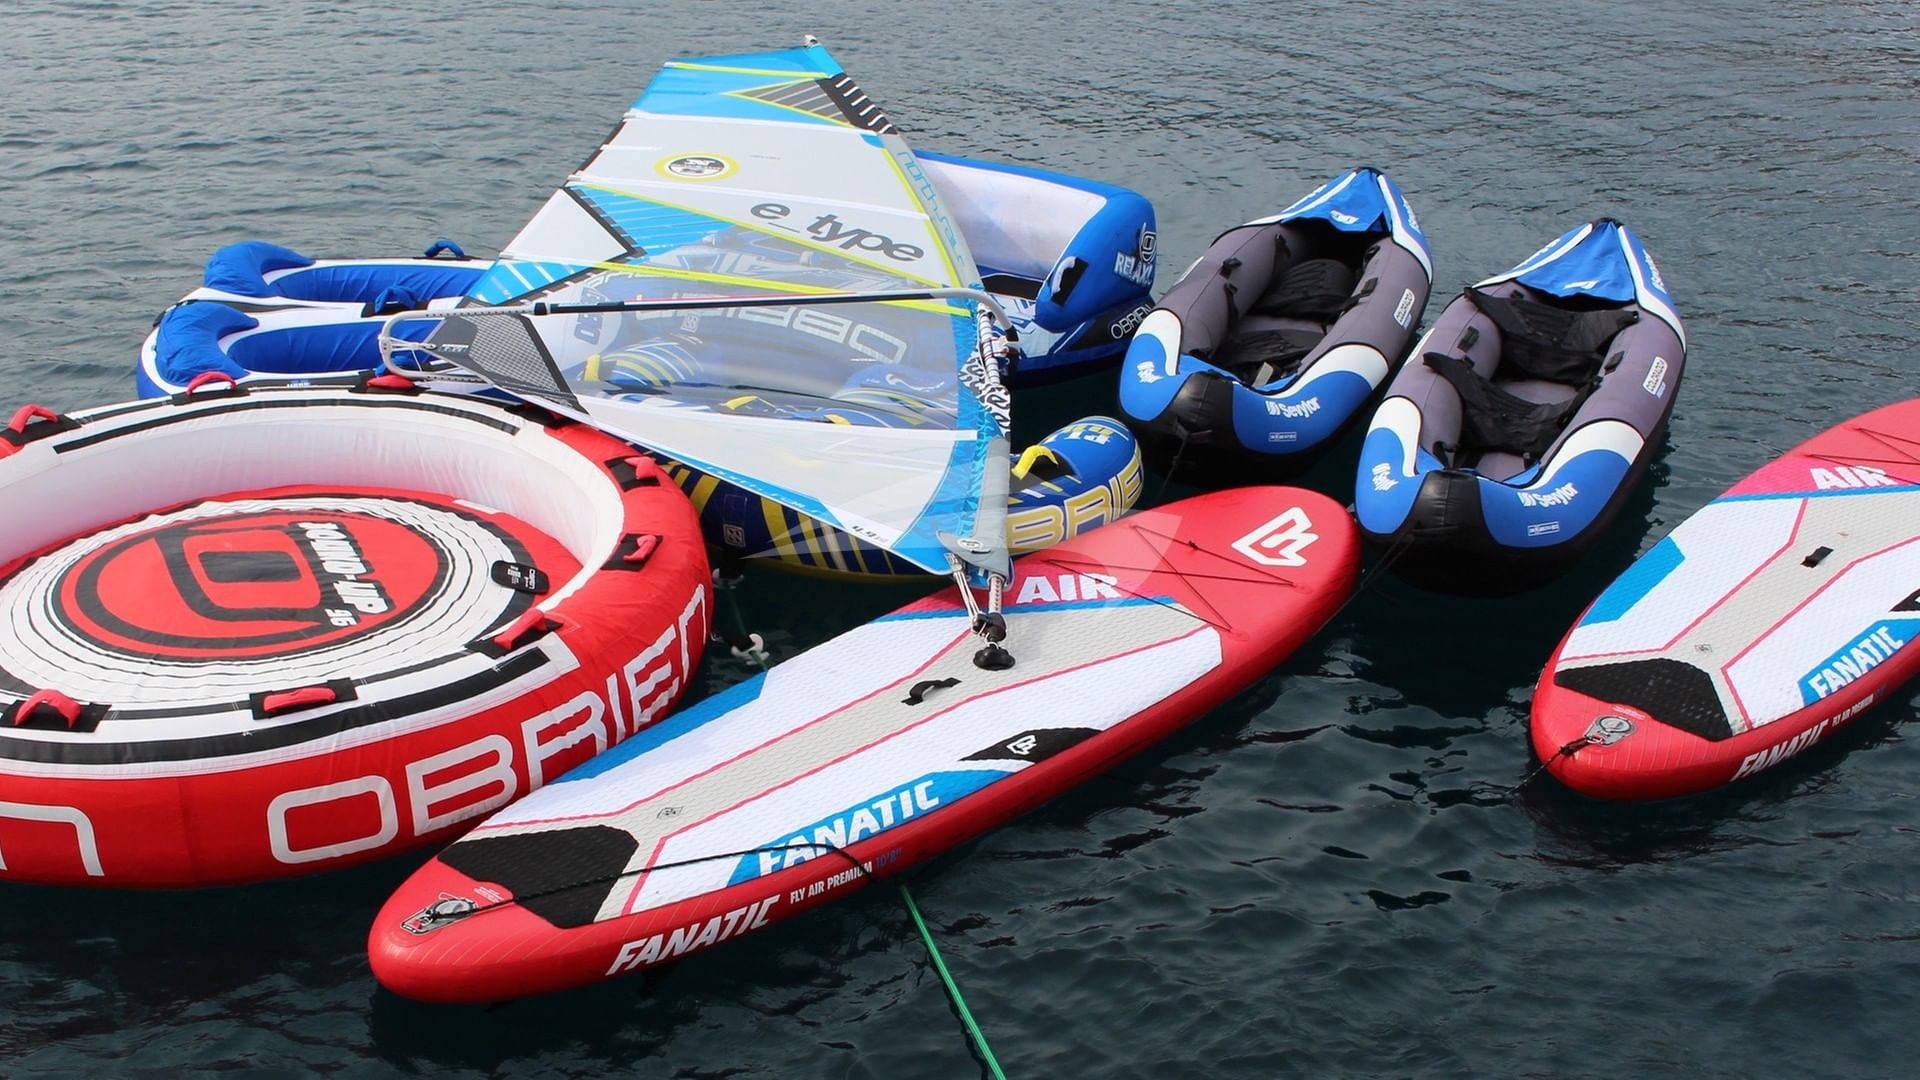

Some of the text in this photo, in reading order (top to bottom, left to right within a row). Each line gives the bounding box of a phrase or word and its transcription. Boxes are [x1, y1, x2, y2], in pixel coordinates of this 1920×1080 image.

[750, 203, 924, 261] e_type
[1809, 465, 1899, 490] AIR
[1016, 572, 1122, 604] AIR
[1807, 626, 1904, 700] FANATIC
[758, 780, 940, 877] FANATIC
[790, 887, 806, 905] FLY
[808, 880, 824, 897] AIR
[827, 861, 872, 891] PREMIUM
[605, 894, 781, 976] FANATIC
